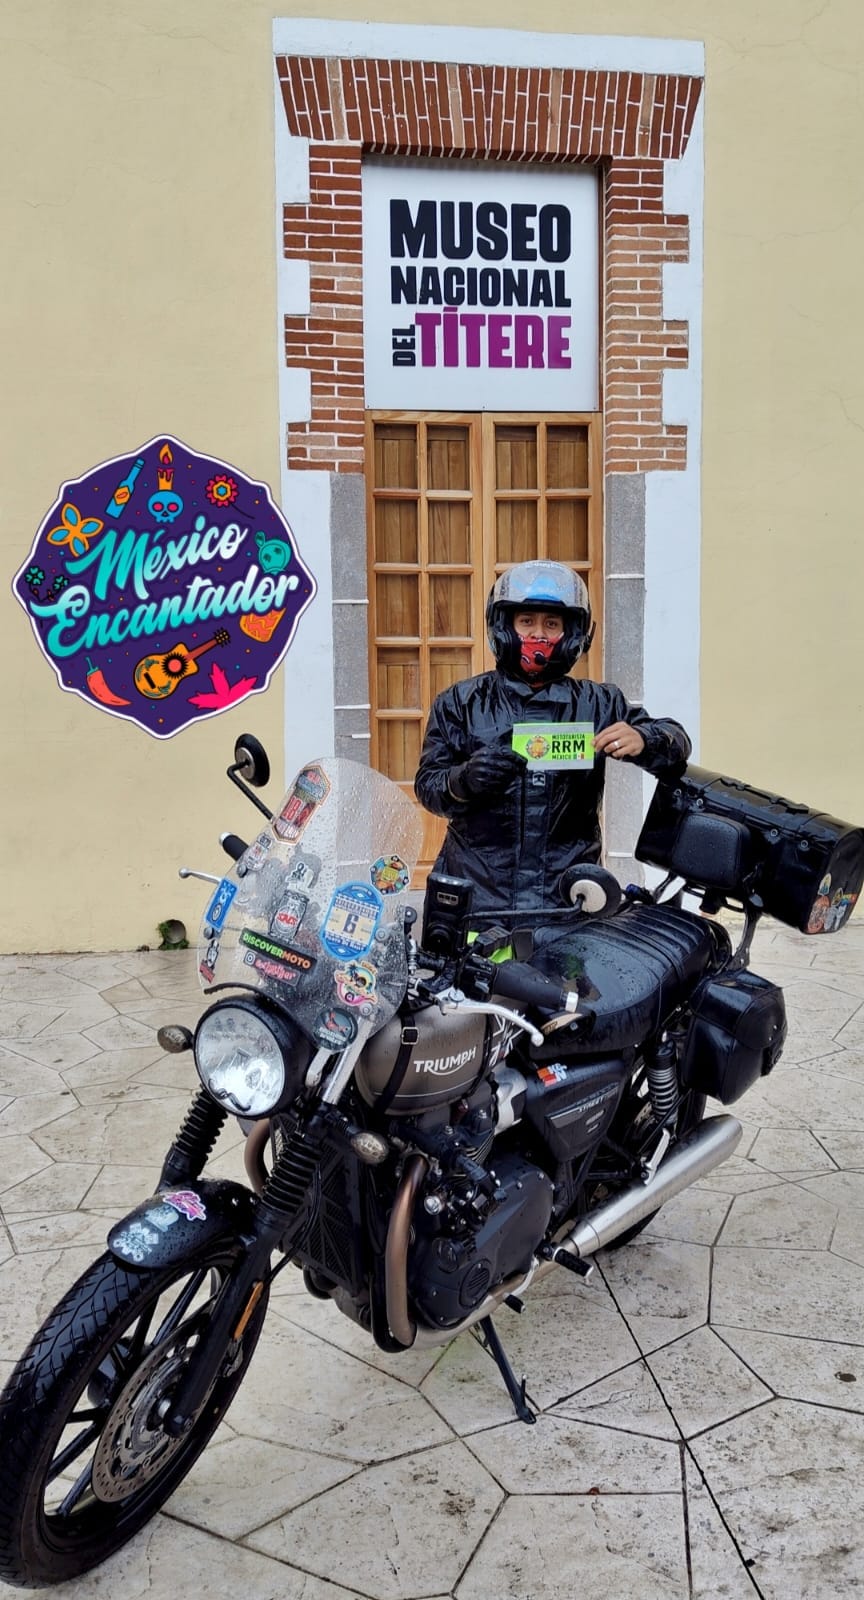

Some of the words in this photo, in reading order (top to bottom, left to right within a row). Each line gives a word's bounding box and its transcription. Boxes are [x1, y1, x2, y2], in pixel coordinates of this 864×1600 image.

[389, 198, 572, 263] MUSEO
[390, 265, 572, 308] NACIONAL
[391, 323, 416, 367] DEL
[414, 306, 572, 369] TÍTERE
[551, 739, 586, 754] RRM
[413, 1046, 477, 1076] TRIUMPH
